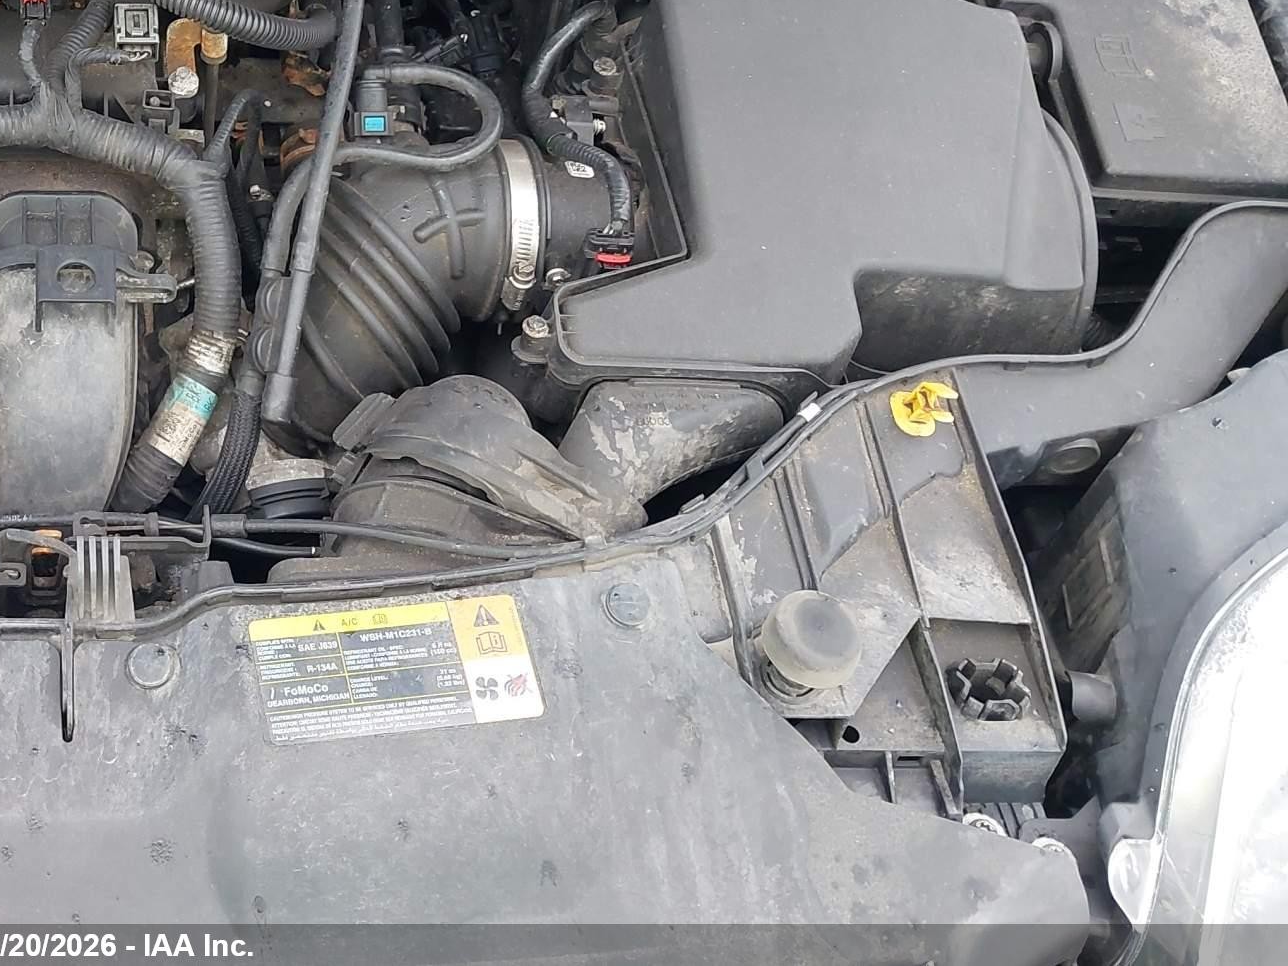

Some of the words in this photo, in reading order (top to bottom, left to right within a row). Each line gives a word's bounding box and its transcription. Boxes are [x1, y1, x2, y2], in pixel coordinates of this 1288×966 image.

[341, 617, 359, 627] A/C
[359, 627, 433, 643] WSH-M1C231-B
[297, 642, 317, 653] SAE
[317, 640, 338, 651] J639
[306, 661, 338, 674] R-134A
[283, 683, 329, 697] FoMoCo
[267, 696, 313, 709] DEARBORN,
[313, 692, 350, 705] MICHIGAN
